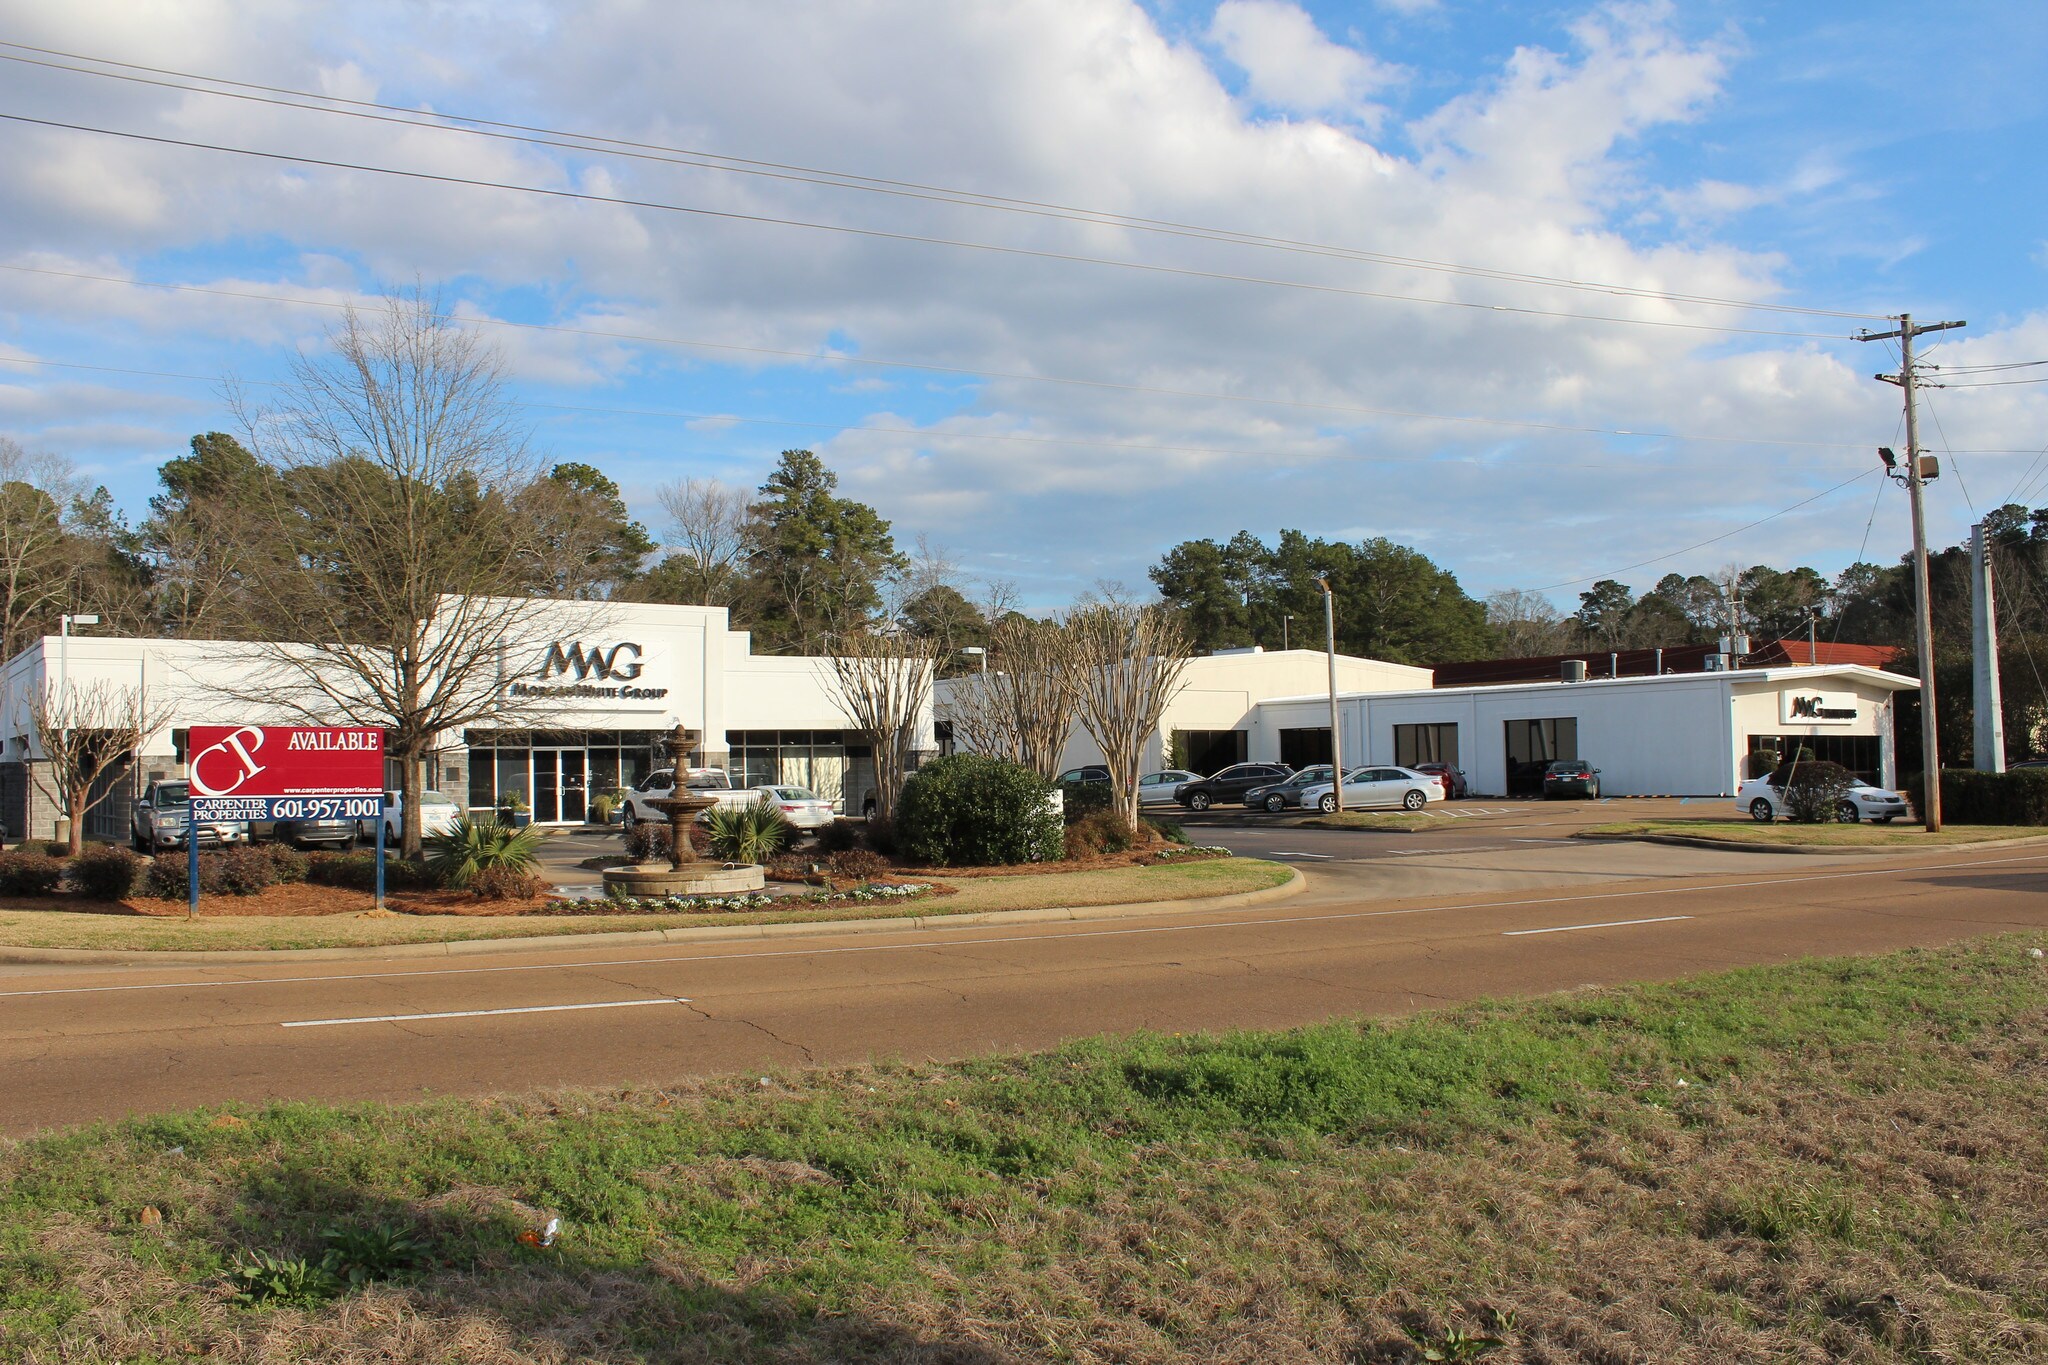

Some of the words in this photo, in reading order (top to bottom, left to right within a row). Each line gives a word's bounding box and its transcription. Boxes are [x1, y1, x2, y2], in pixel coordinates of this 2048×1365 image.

[537, 641, 645, 682] MWG
[287, 731, 379, 751] AVAILABLE
[190, 725, 267, 796] CP
[193, 799, 268, 809] CARPENTER
[272, 798, 381, 819] 601-957-1001
[193, 809, 268, 820] PROPERTIES
